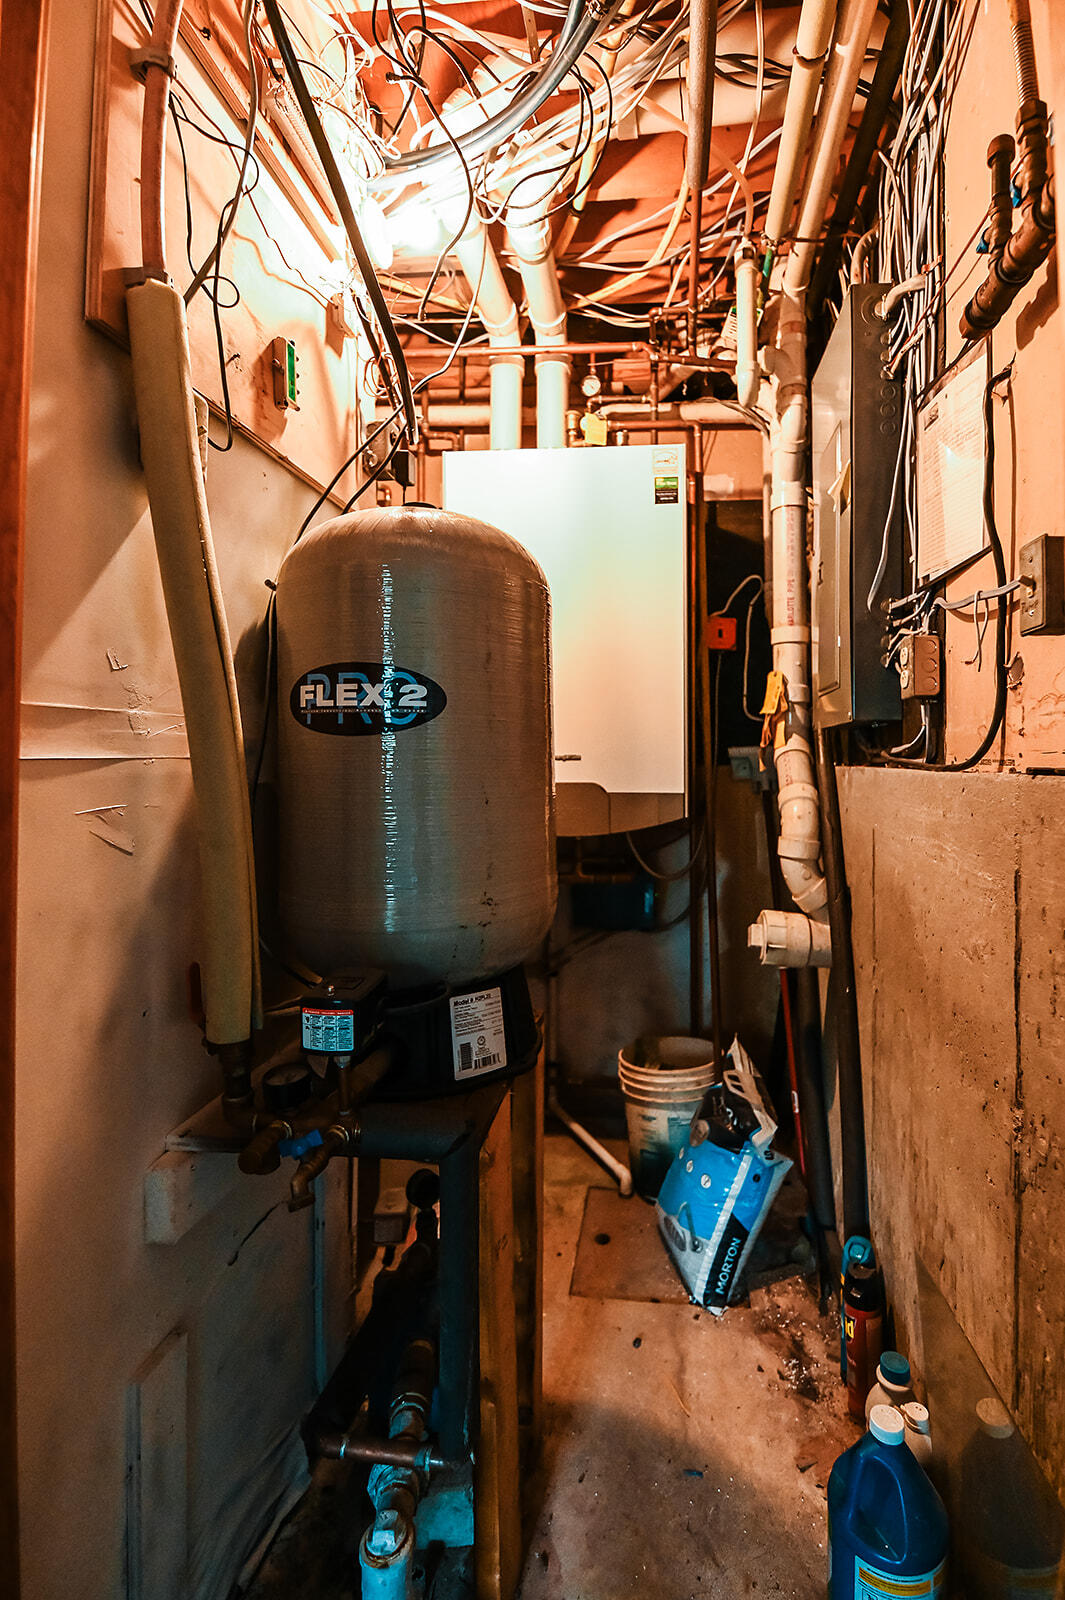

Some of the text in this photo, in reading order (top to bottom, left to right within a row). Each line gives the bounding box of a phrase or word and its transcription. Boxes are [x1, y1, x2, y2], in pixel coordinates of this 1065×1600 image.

[300, 683, 427, 708] FLEX 2
[715, 1237, 742, 1295] MORTON
